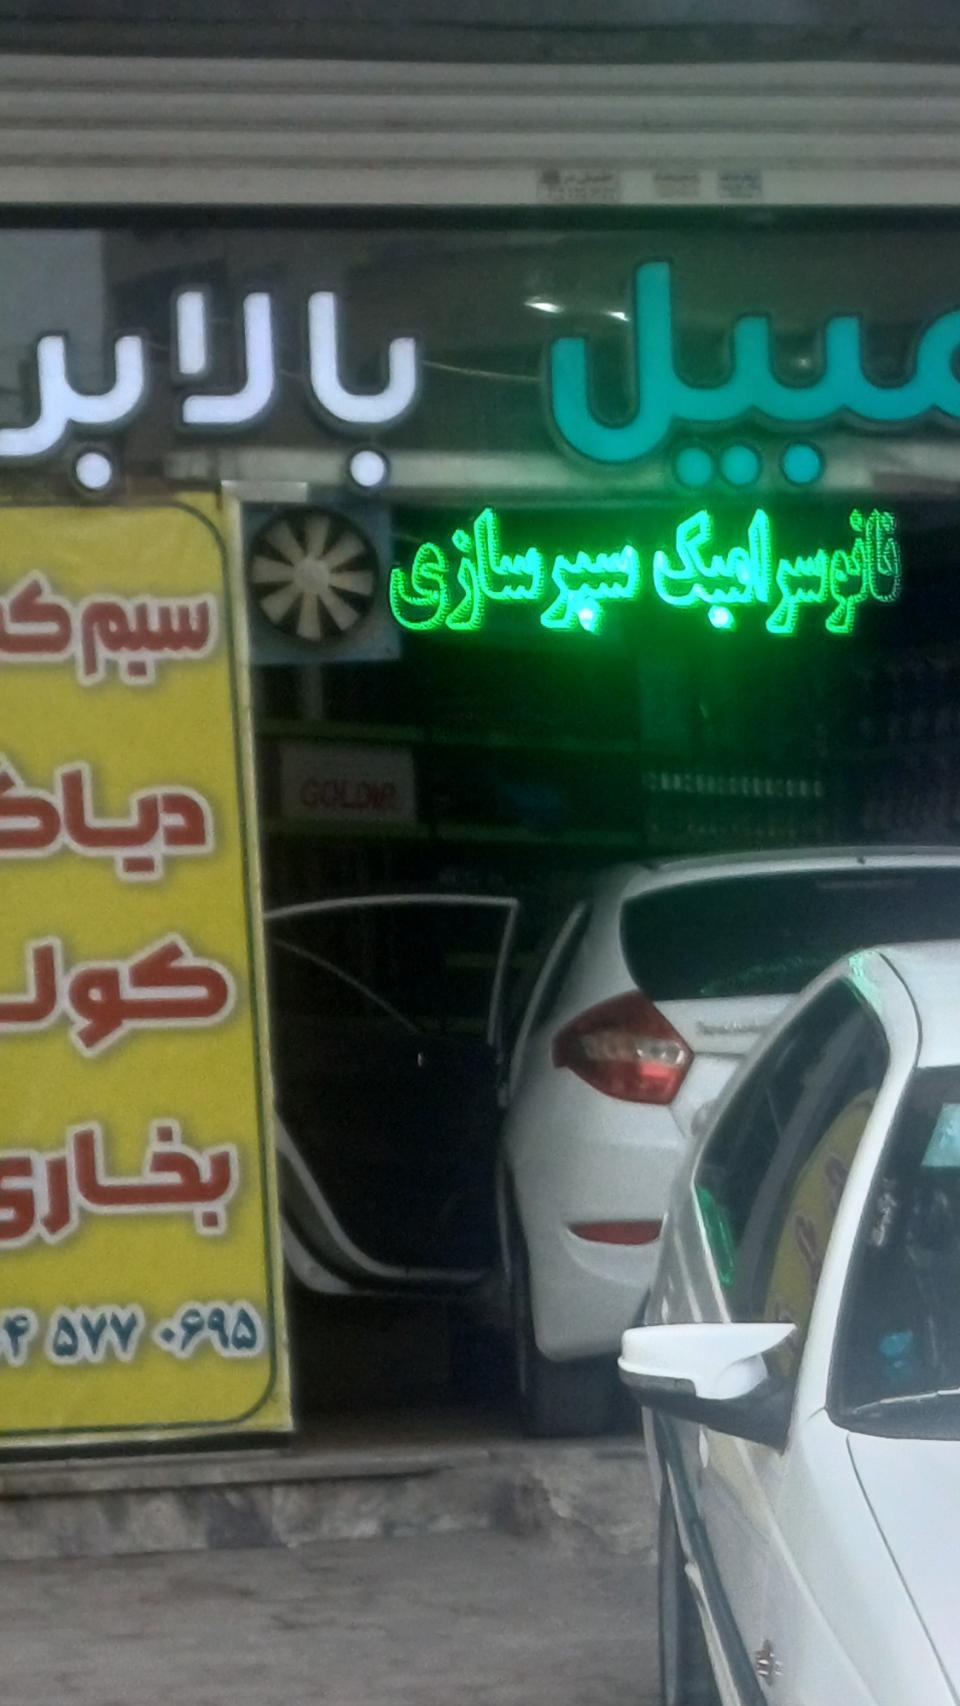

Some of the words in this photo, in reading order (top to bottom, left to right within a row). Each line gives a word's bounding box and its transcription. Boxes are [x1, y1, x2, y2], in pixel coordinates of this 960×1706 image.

[389, 507, 544, 632] سازی
[652, 507, 828, 634] سرامیک
[825, 507, 900, 634] نانو
[0, 940, 229, 1050] کول
[0, 1314, 31, 1358] ۴
[52, 1311, 138, 1357] ۵۷۷
[159, 1306, 258, 1351] ۰۶۹۵
